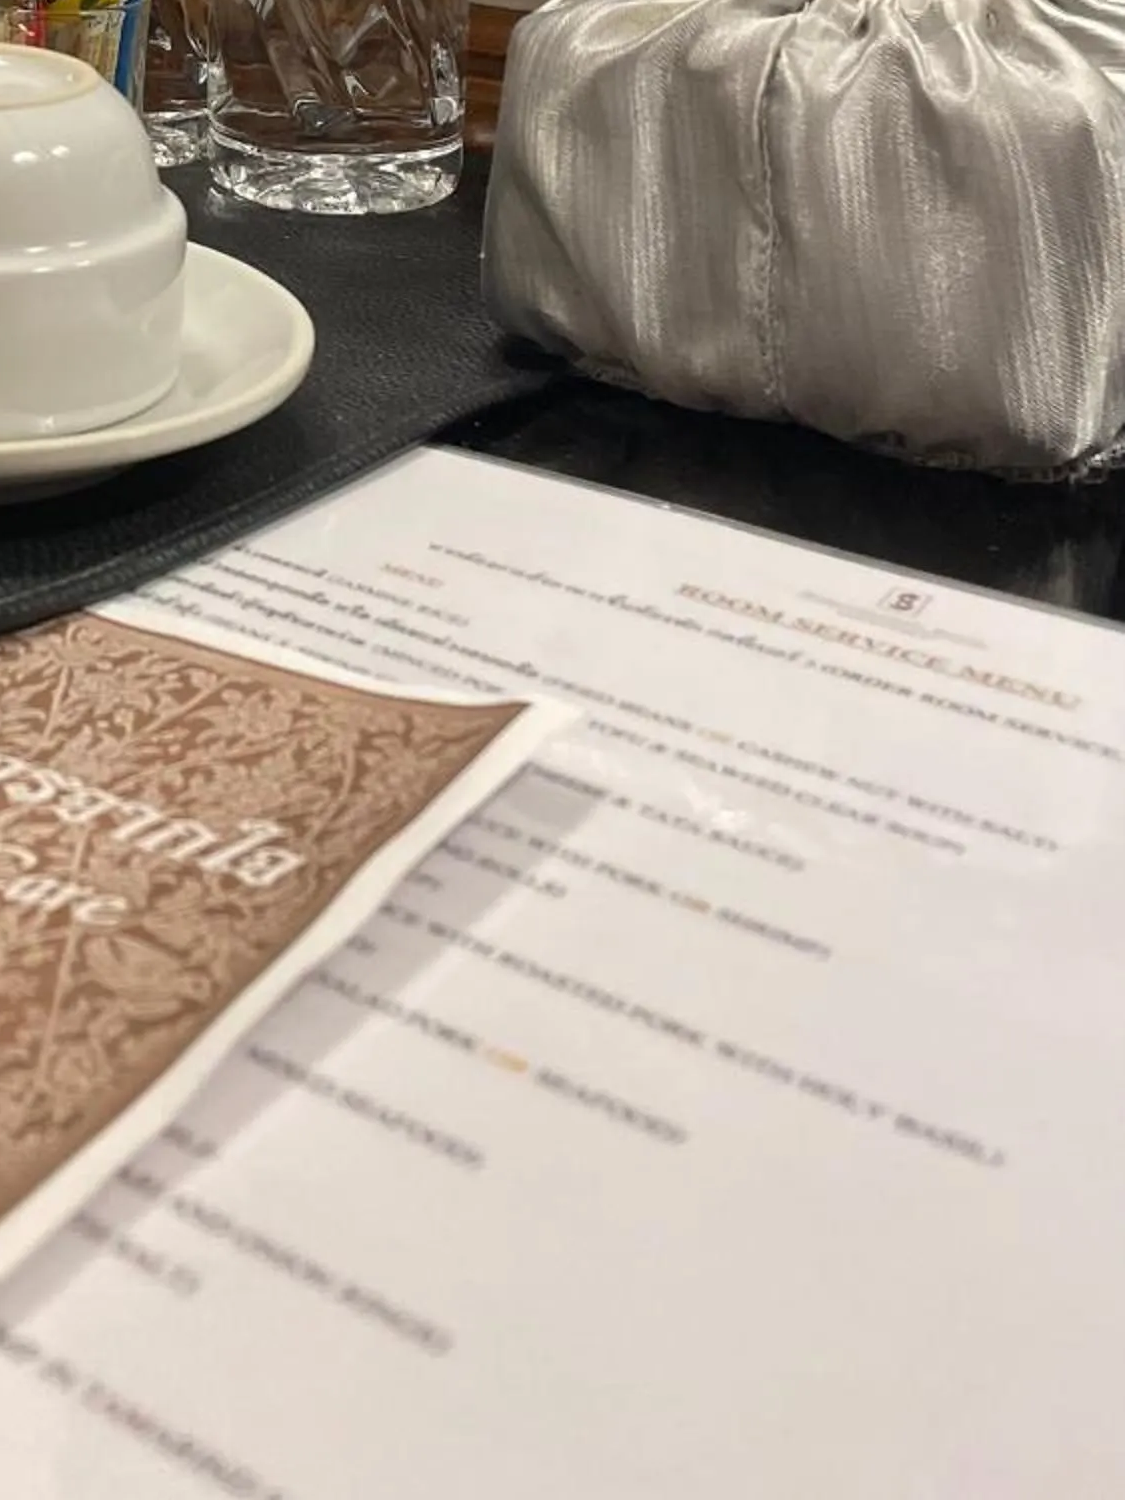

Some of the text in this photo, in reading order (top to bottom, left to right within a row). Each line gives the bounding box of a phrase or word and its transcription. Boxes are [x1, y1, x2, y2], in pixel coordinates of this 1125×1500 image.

[676, 582, 784, 626] ROOM
[793, 614, 953, 678] SERVICE
[958, 664, 1084, 710] MENU
